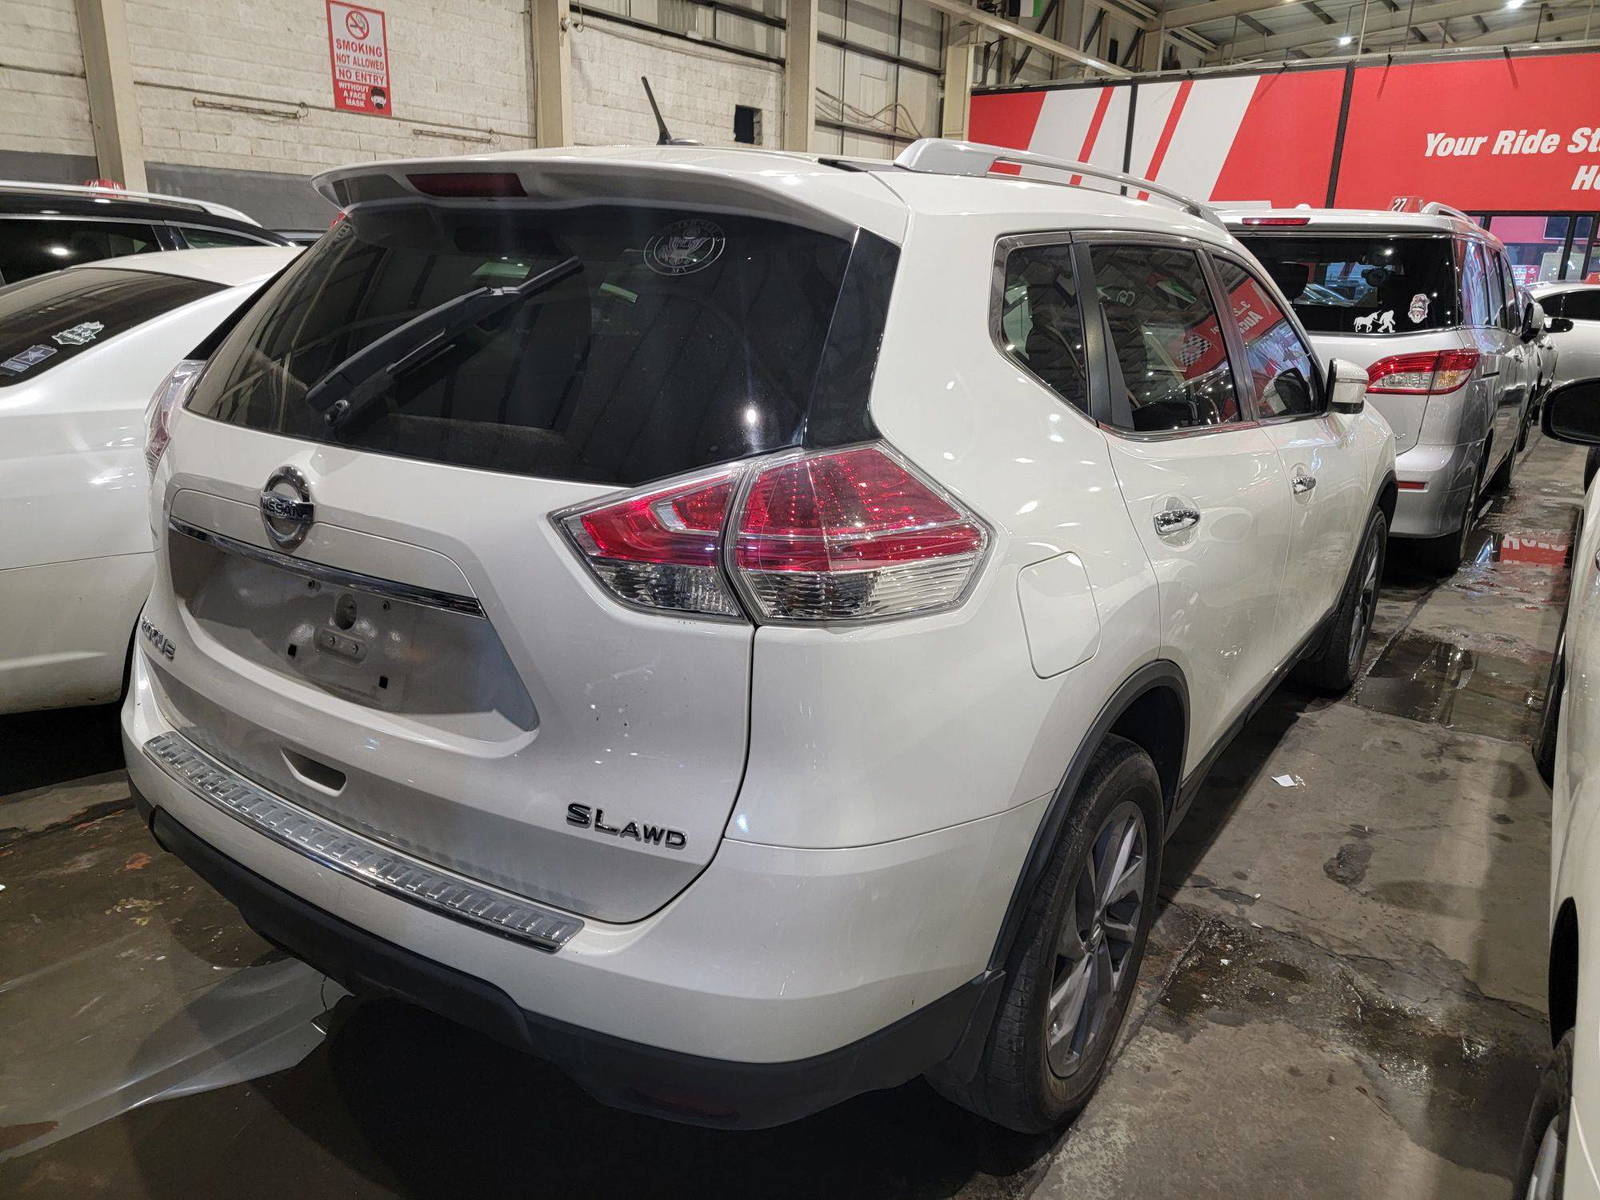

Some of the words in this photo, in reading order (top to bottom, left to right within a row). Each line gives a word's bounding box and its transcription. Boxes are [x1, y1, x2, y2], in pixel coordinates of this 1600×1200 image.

[336, 39, 382, 57] SMOKING
[336, 53, 350, 65] NOT
[353, 56, 384, 71] ALLOWED
[339, 68, 352, 79] NO
[355, 71, 384, 85] ENTRY
[339, 82, 369, 92] WITHOUT
[349, 91, 366, 100] FACE
[345, 98, 365, 107] MASK
[1424, 132, 1488, 157] Your
[1491, 128, 1561, 155] Ride
